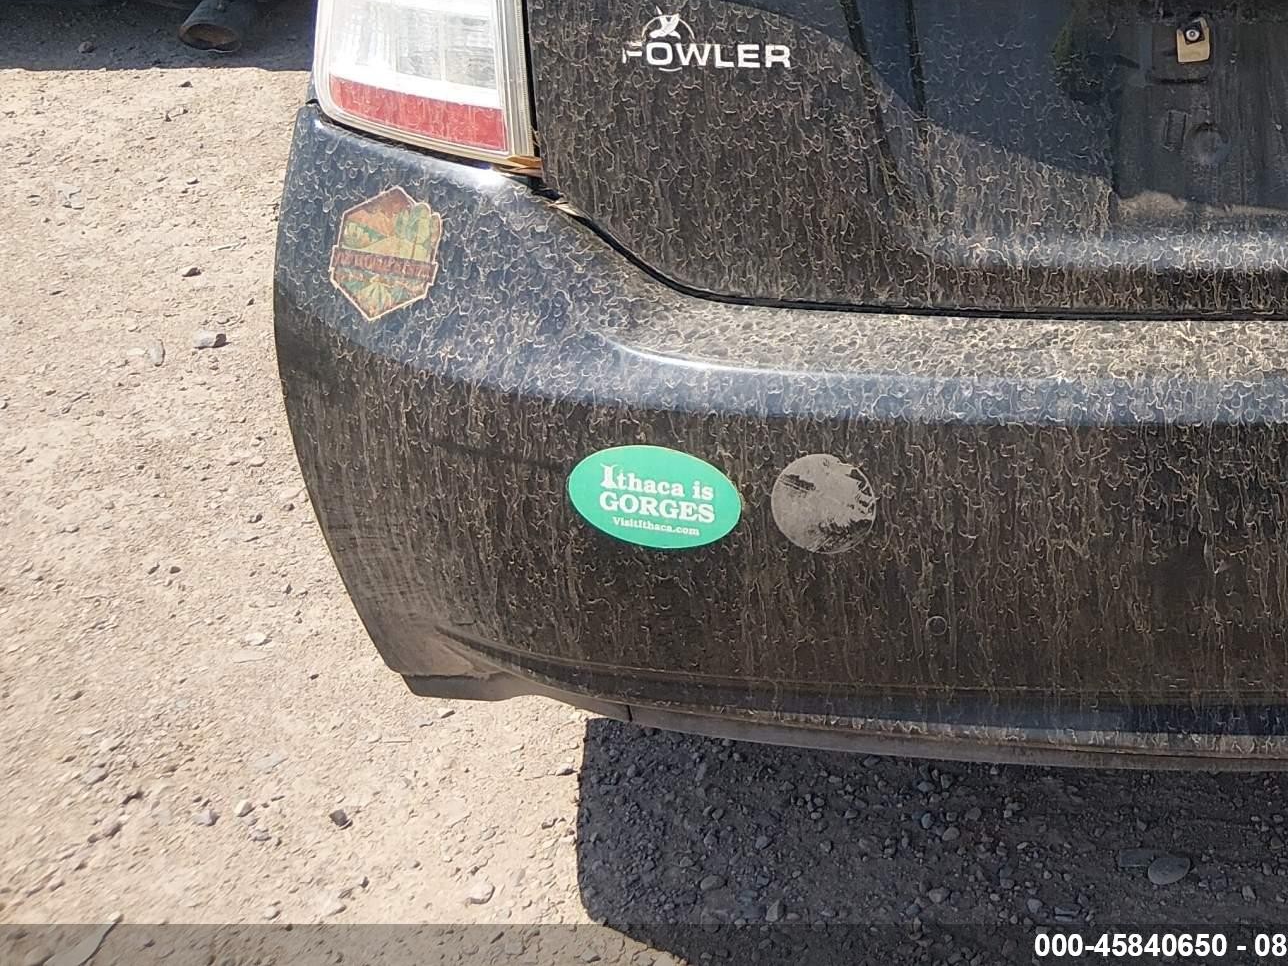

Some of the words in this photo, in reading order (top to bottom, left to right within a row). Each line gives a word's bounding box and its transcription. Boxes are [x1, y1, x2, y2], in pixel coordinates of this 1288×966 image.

[621, 40, 791, 69] FOWLER
[600, 464, 685, 498] Ithaca
[692, 481, 714, 500] is
[599, 491, 715, 523] GORGES
[612, 516, 700, 536] VisitIthaca.com
